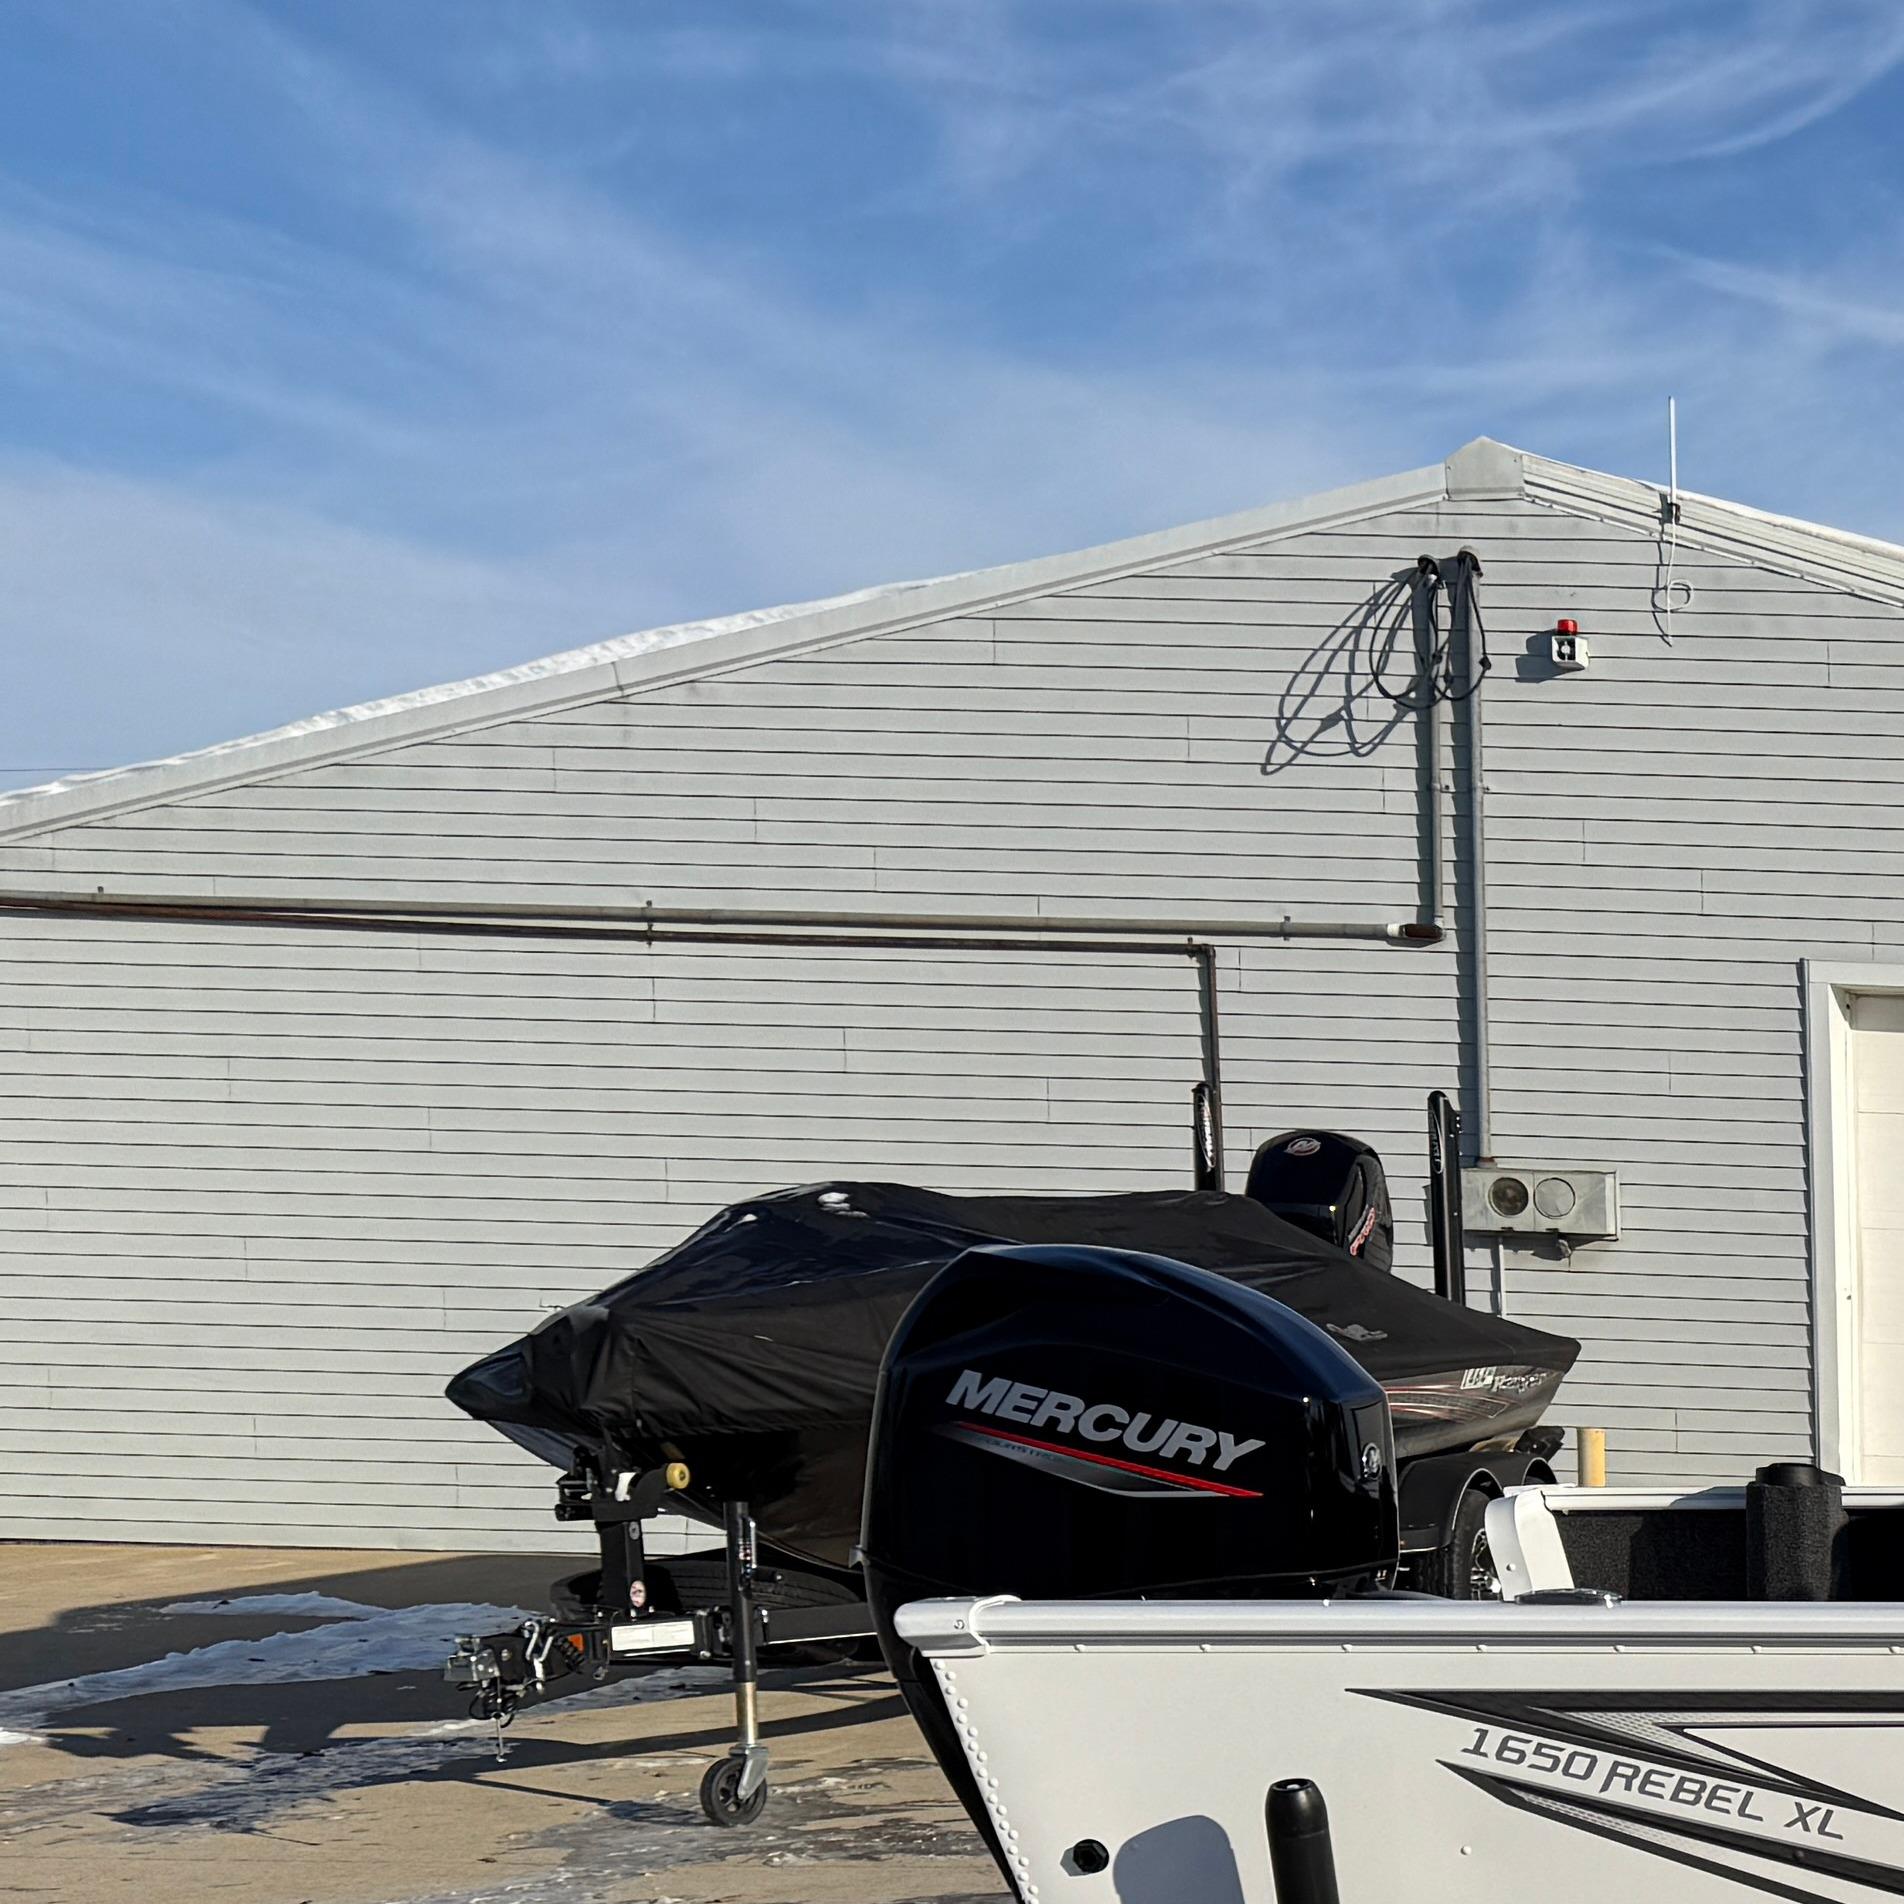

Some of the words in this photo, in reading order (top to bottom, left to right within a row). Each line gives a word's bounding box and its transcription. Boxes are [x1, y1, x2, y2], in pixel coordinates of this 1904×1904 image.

[945, 1369, 1267, 1471] MERCURY
[1462, 1727, 1597, 1781] 1650
[1600, 1758, 1764, 1822] REBEL
[1784, 1800, 1844, 1841] XL
